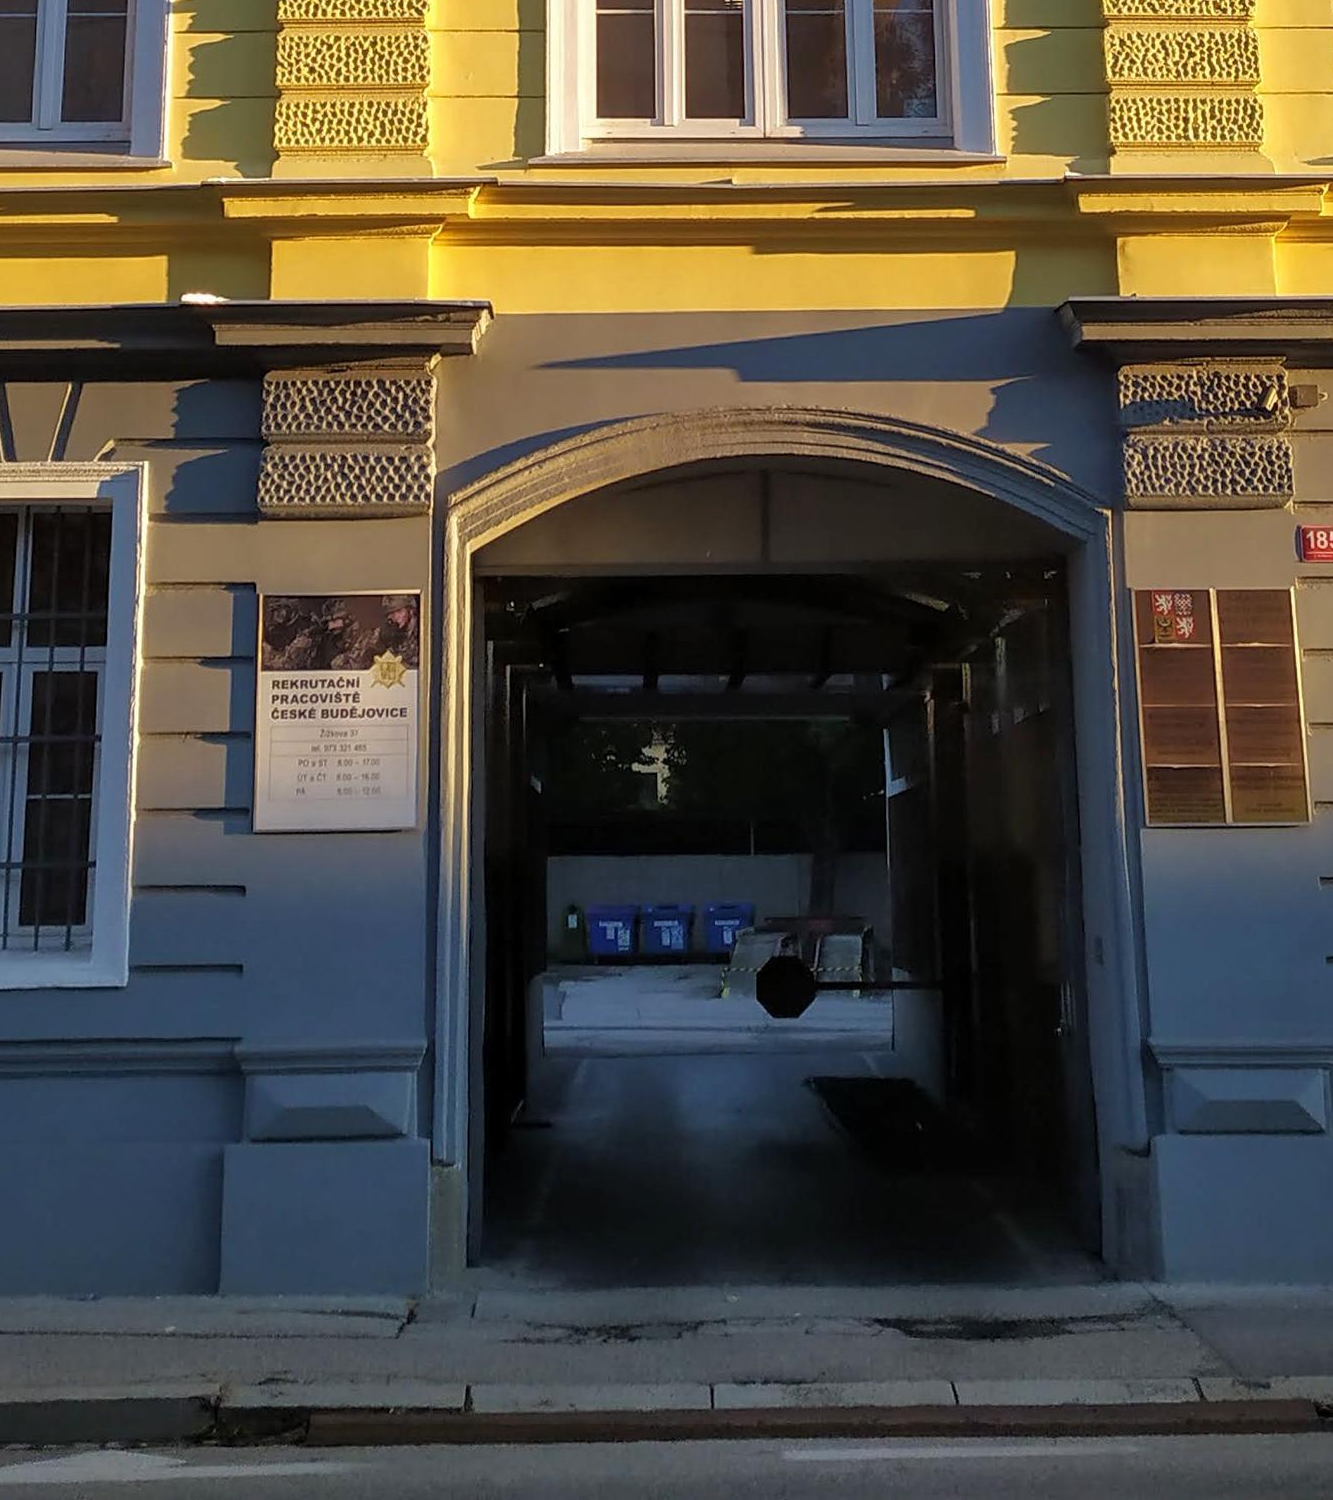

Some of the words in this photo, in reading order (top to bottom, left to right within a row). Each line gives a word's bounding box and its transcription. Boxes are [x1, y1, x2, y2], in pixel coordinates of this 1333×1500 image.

[271, 676, 360, 690] REKRUTAČNÍ
[271, 691, 361, 705] PRACOVIŠTĚ
[271, 707, 317, 720] ČESKÉ
[320, 706, 408, 719] BUDĚJOVICE
[319, 728, 348, 739] Žižkova
[350, 729, 359, 738] 37
